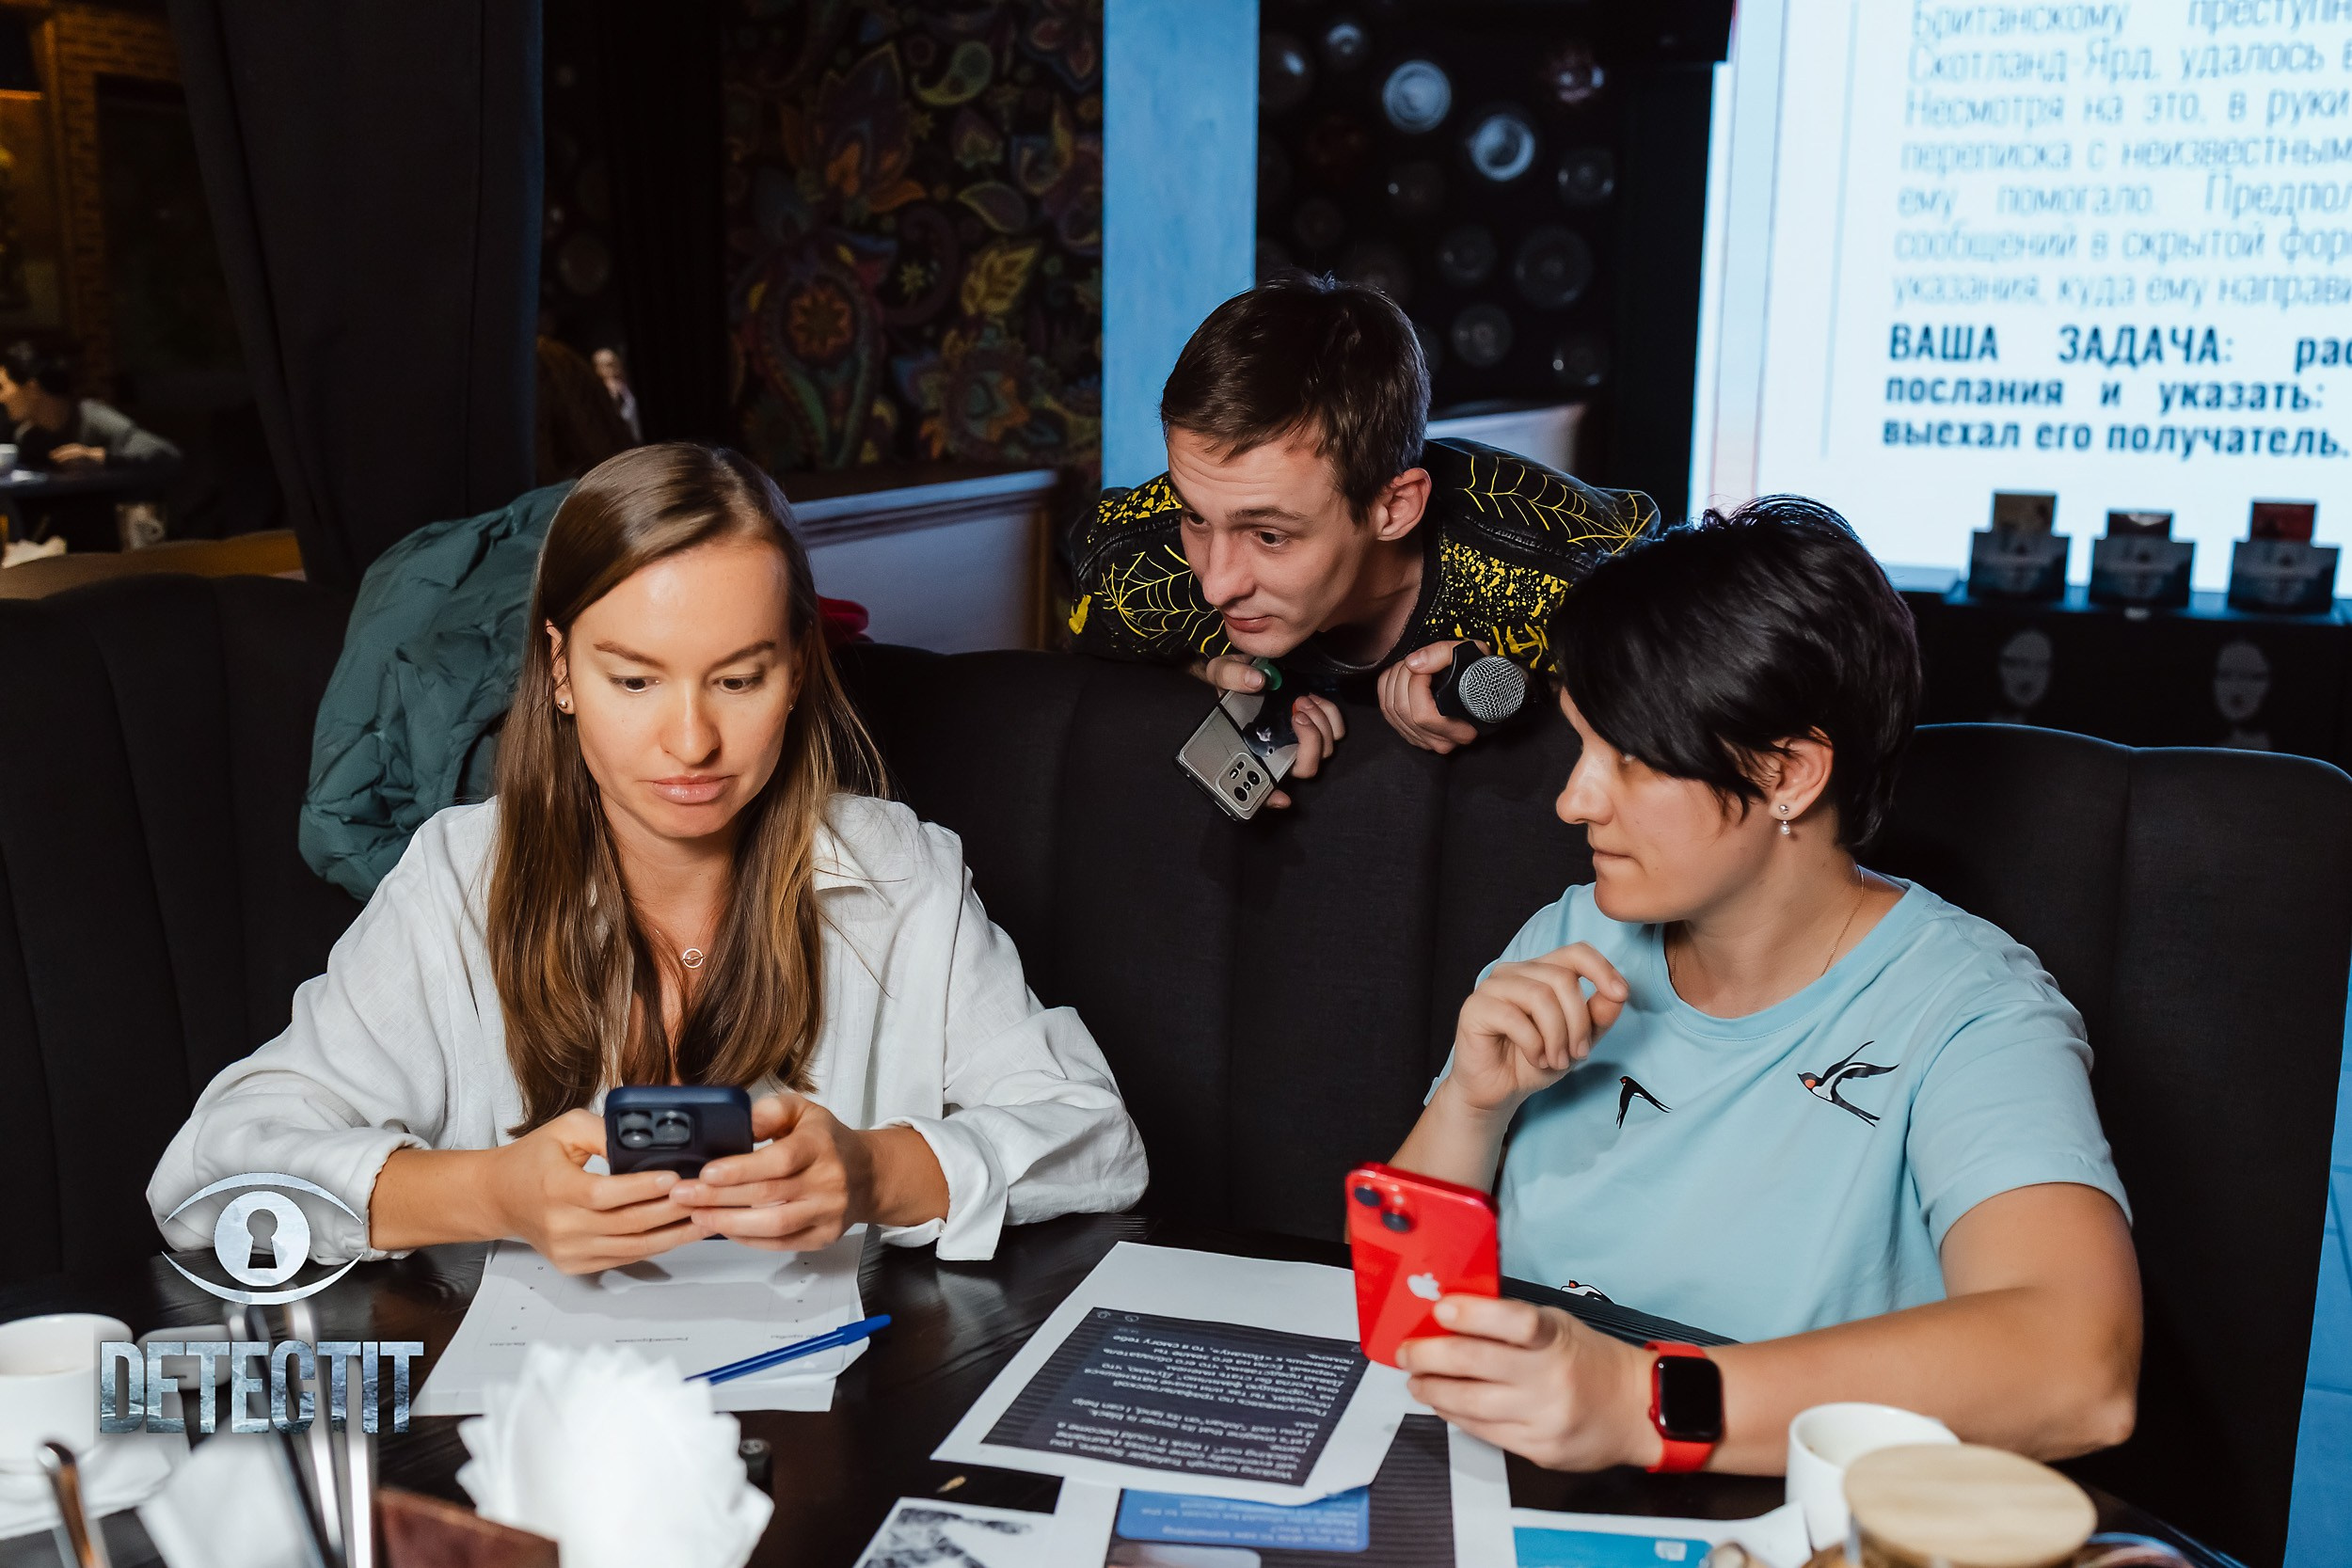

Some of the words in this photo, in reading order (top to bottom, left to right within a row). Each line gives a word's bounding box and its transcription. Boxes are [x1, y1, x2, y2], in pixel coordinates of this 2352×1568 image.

[2179, 40, 2325, 82] удалось
[1905, 88, 2064, 135] Несмотря
[2083, 95, 2123, 123] на
[2228, 89, 2248, 123] в
[2265, 88, 2351, 129] руки
[1899, 140, 2072, 179] переписка
[2087, 141, 2107, 169] с
[1898, 186, 1960, 222] ему
[1893, 218, 2076, 262] сообщений
[2090, 232, 2108, 261] в
[2122, 221, 2265, 266] скрытой
[2058, 274, 2136, 309] куда
[2146, 274, 2207, 309] ему
[1887, 323, 1999, 363] ВАША
[2057, 325, 2234, 371] ЗАДАЧА:
[1884, 376, 2064, 405] послания
[2100, 380, 2122, 406] и
[2159, 381, 2325, 417] указать:
[1882, 419, 2021, 449] выехал
[2035, 421, 2092, 451] его
[2106, 423, 2349, 462] получатель.
[1113, 1335, 1139, 1343] тебе
[1143, 1338, 1179, 1349] смогу
[1103, 1348, 1173, 1363] обладатель
[1171, 1351, 1210, 1360] земле
[1102, 1362, 1122, 1370] что
[1253, 1362, 1283, 1370] Если
[1218, 1371, 1252, 1381] стать
[1304, 1375, 1343, 1387] Давай
[1276, 1379, 1313, 1389] могла
[1316, 1385, 1339, 1394] она
